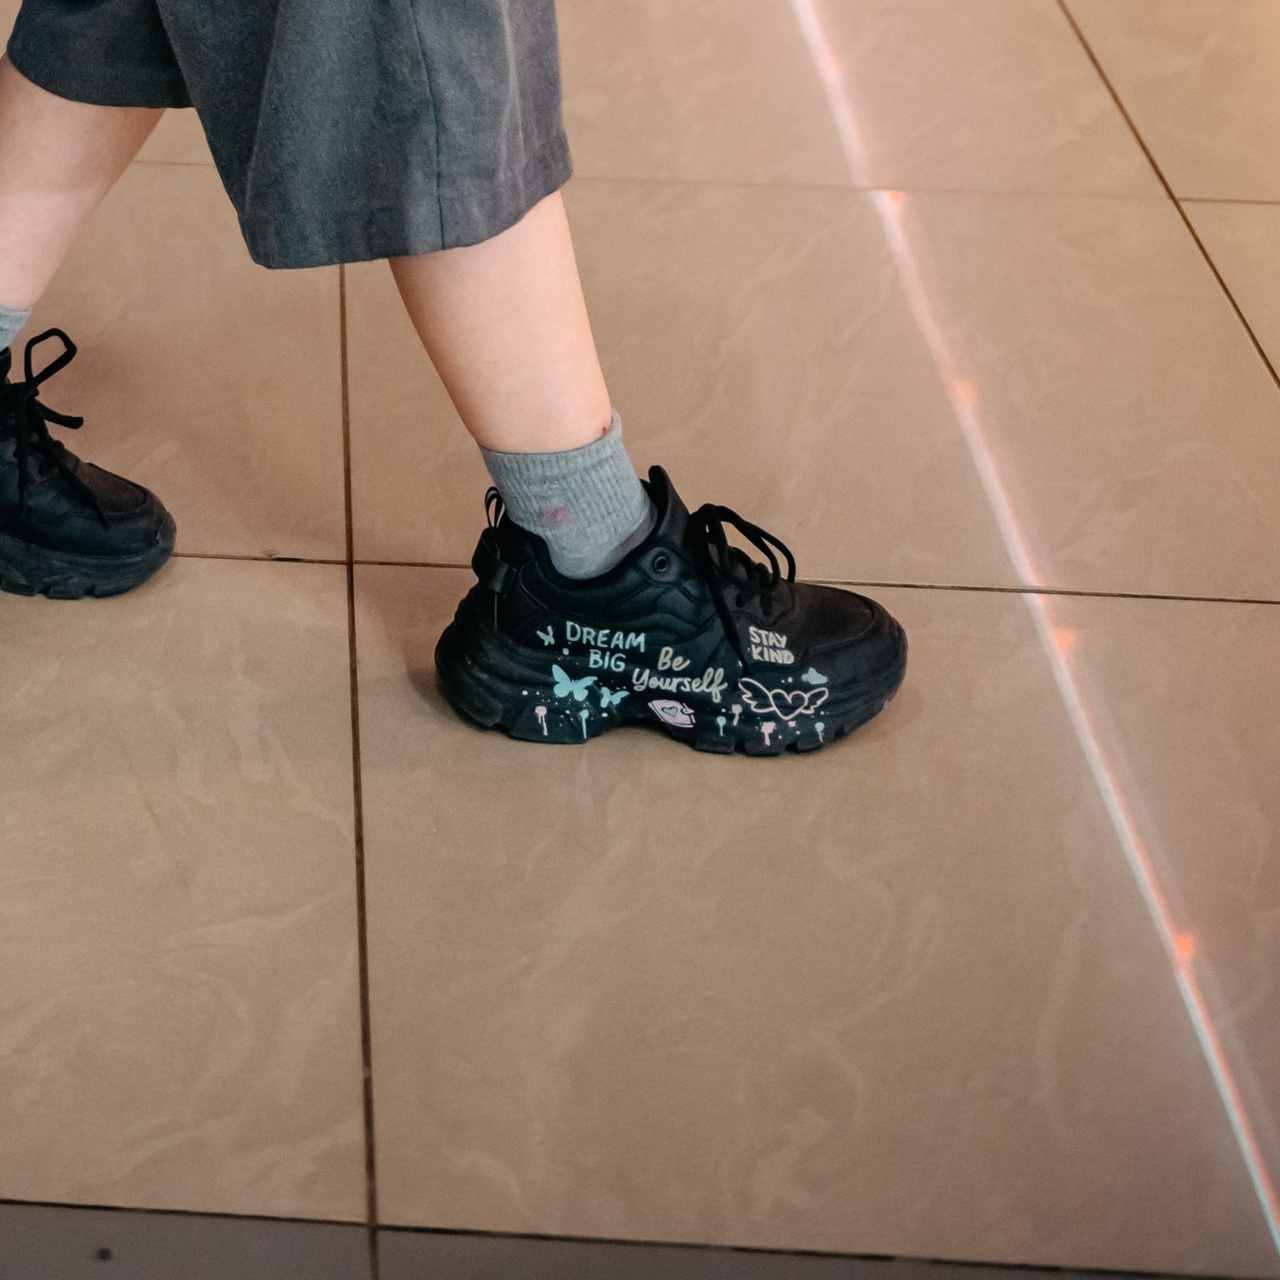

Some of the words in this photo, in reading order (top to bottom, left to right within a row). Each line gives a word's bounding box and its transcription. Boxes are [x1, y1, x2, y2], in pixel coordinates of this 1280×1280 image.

[566, 621, 646, 653] DREAM
[748, 626, 787, 649] STAY
[589, 648, 626, 672] BIG
[657, 646, 691, 672] Be
[751, 645, 795, 665] KIND
[632, 667, 728, 704] Yourself
